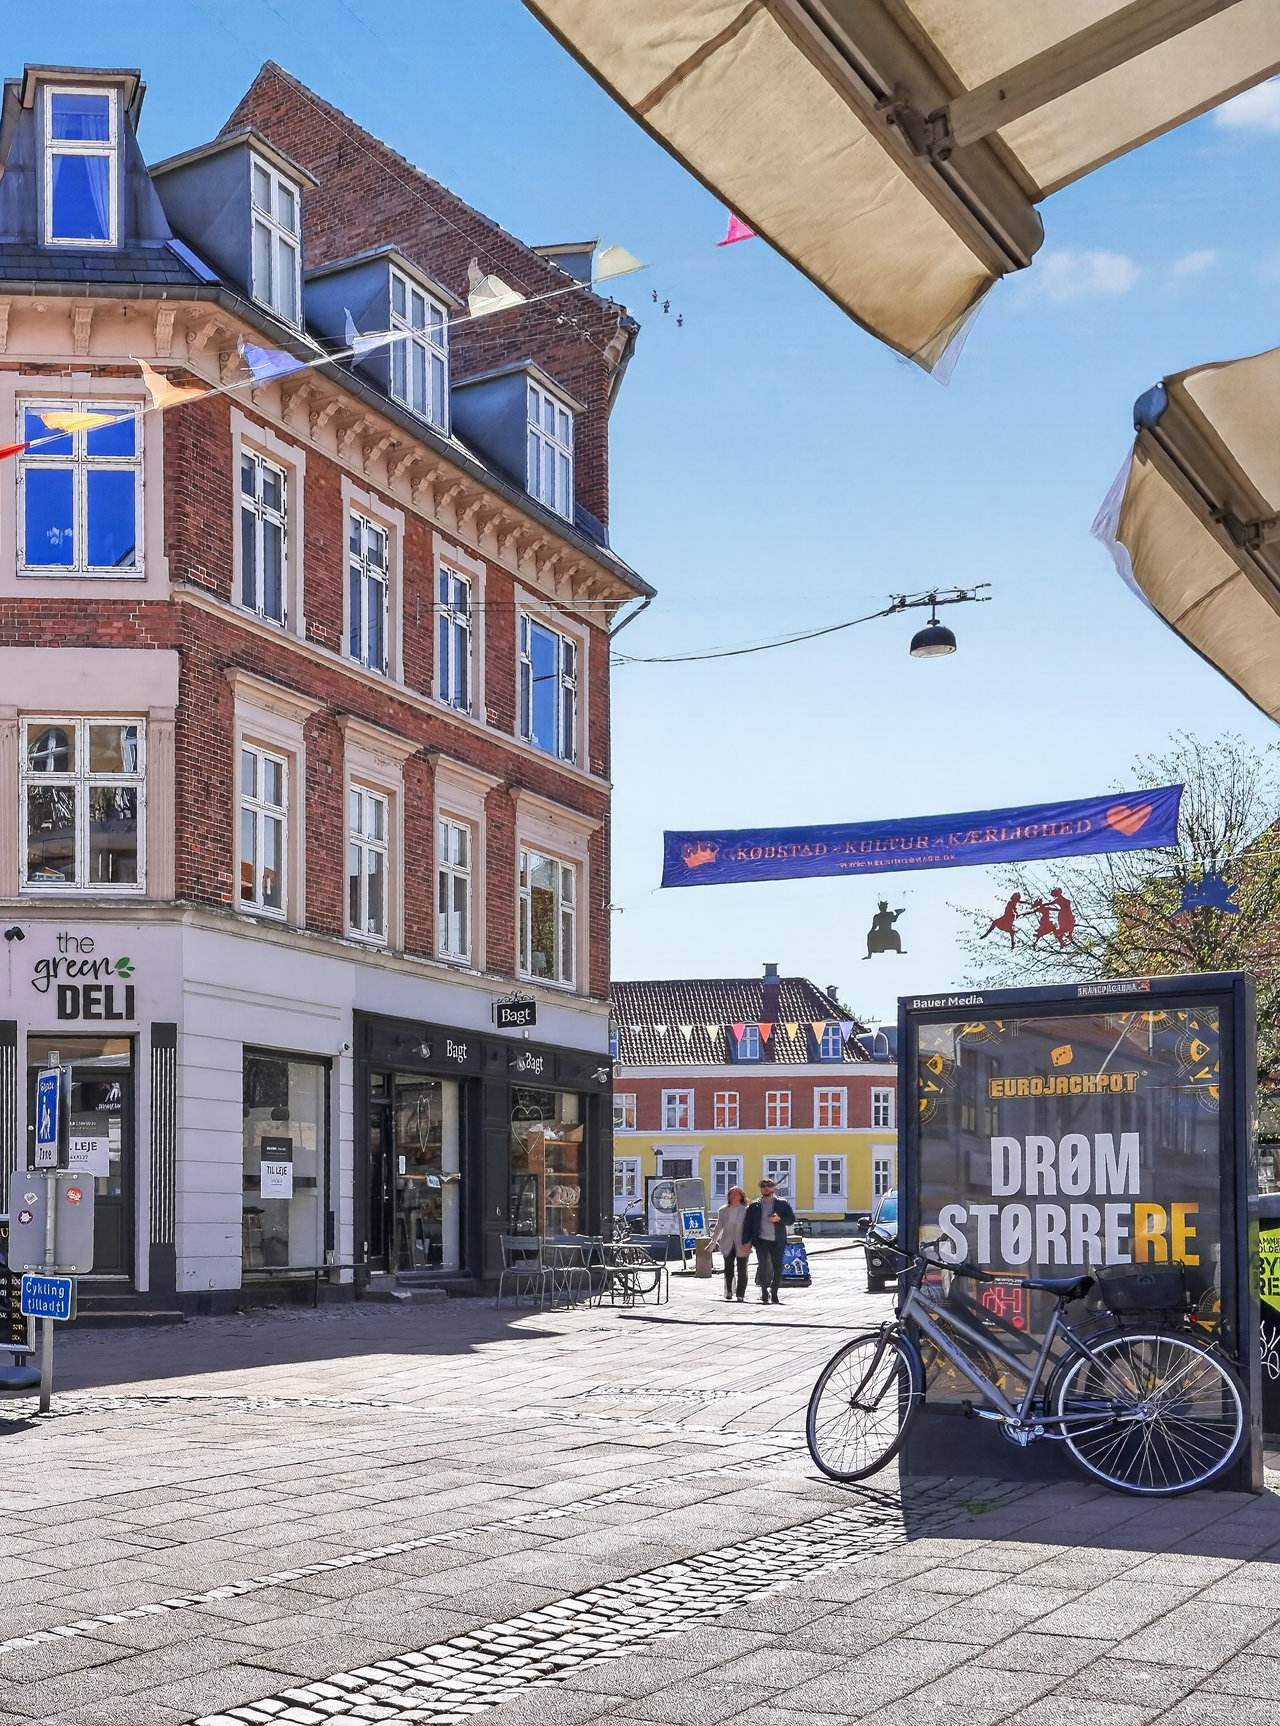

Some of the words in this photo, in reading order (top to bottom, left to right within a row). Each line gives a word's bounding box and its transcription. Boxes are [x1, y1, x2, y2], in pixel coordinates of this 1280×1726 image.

[845, 836, 929, 854] KULTUR
[948, 819, 1093, 847] KÆRLIGHED
[56, 931, 95, 954] the
[31, 956, 115, 993] green
[57, 984, 135, 1020] DELI
[913, 997, 947, 1009] Bauer
[948, 994, 984, 1006] Media
[501, 1008, 531, 1025] Bagt
[446, 1040, 467, 1063] Bagt
[525, 1052, 544, 1075] Bagt
[990, 1071, 1140, 1098] EUROJACKPOT
[74, 1141, 98, 1152] LEJE
[991, 1132, 1140, 1197] DRØM
[938, 1202, 1200, 1266] STØRRERE
[26, 1281, 64, 1299] Cykling
